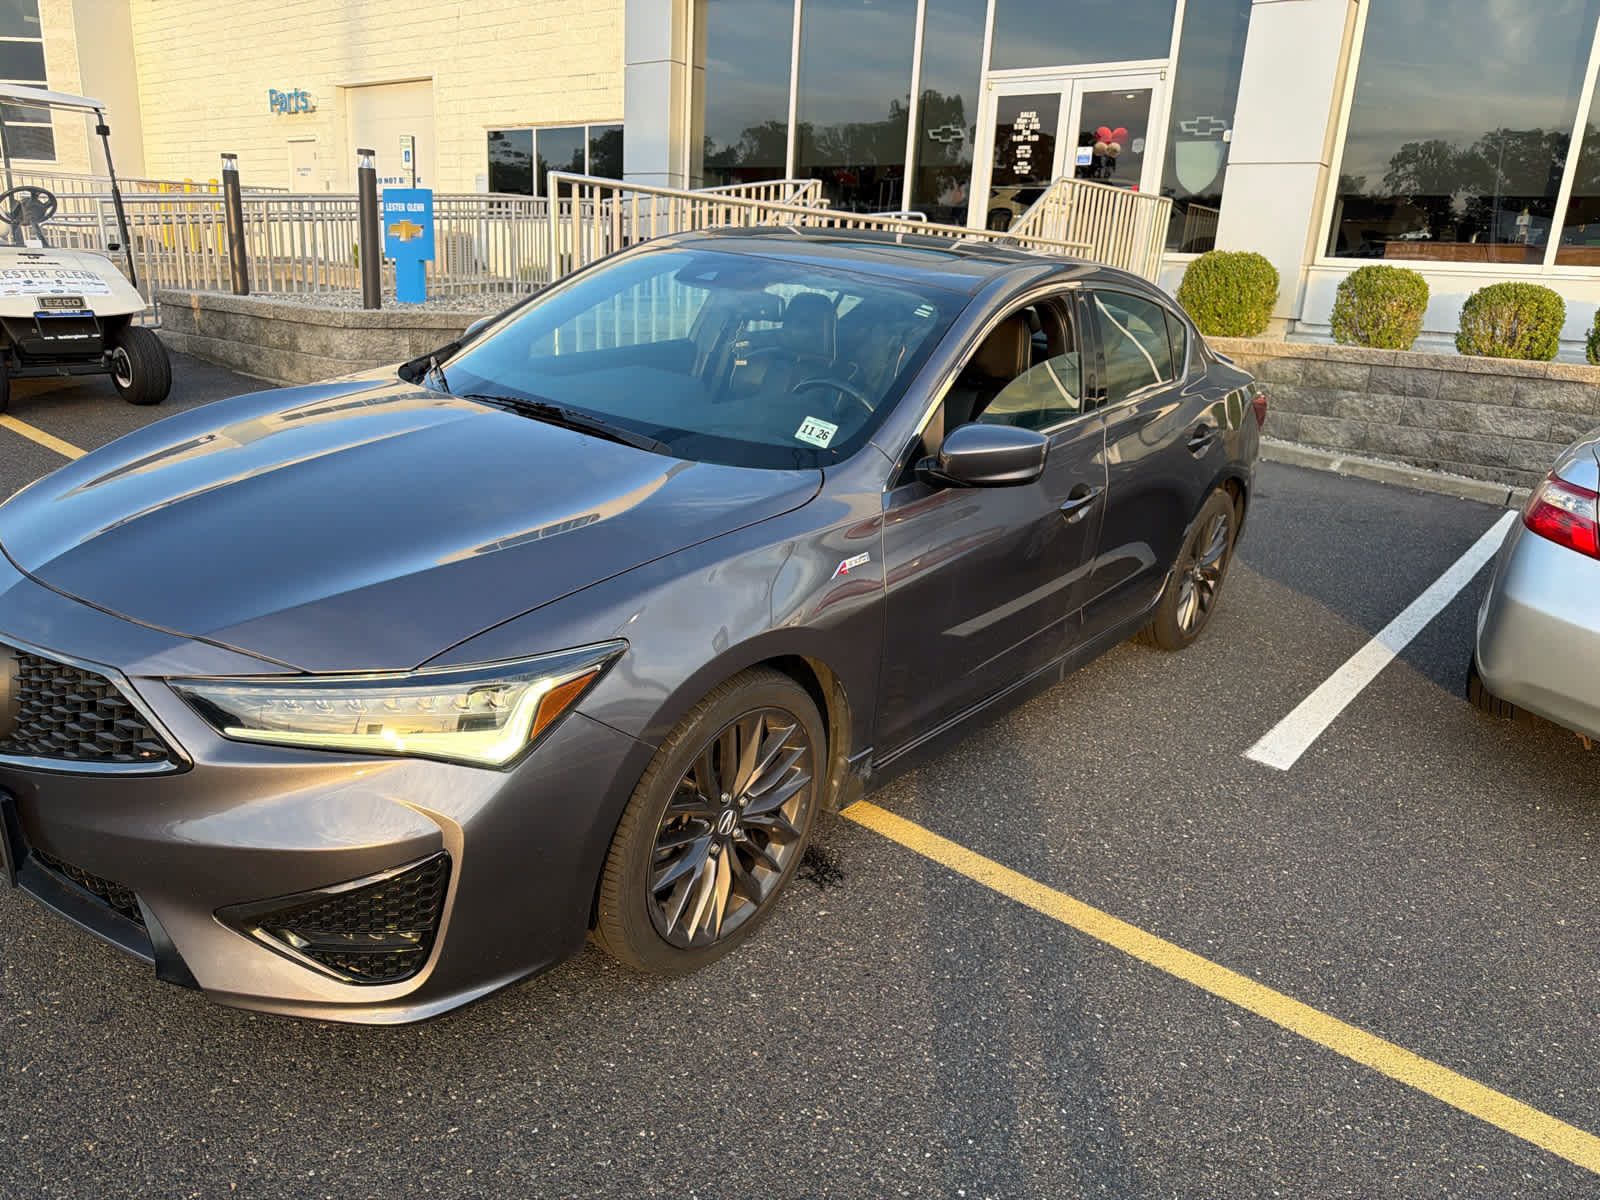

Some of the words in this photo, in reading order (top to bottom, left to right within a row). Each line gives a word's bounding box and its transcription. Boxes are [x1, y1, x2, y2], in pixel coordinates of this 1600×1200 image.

[269, 88, 311, 112] Parts
[55, 270, 101, 281] GLENN
[802, 424, 815, 435] 11
[816, 429, 829, 440] 26
